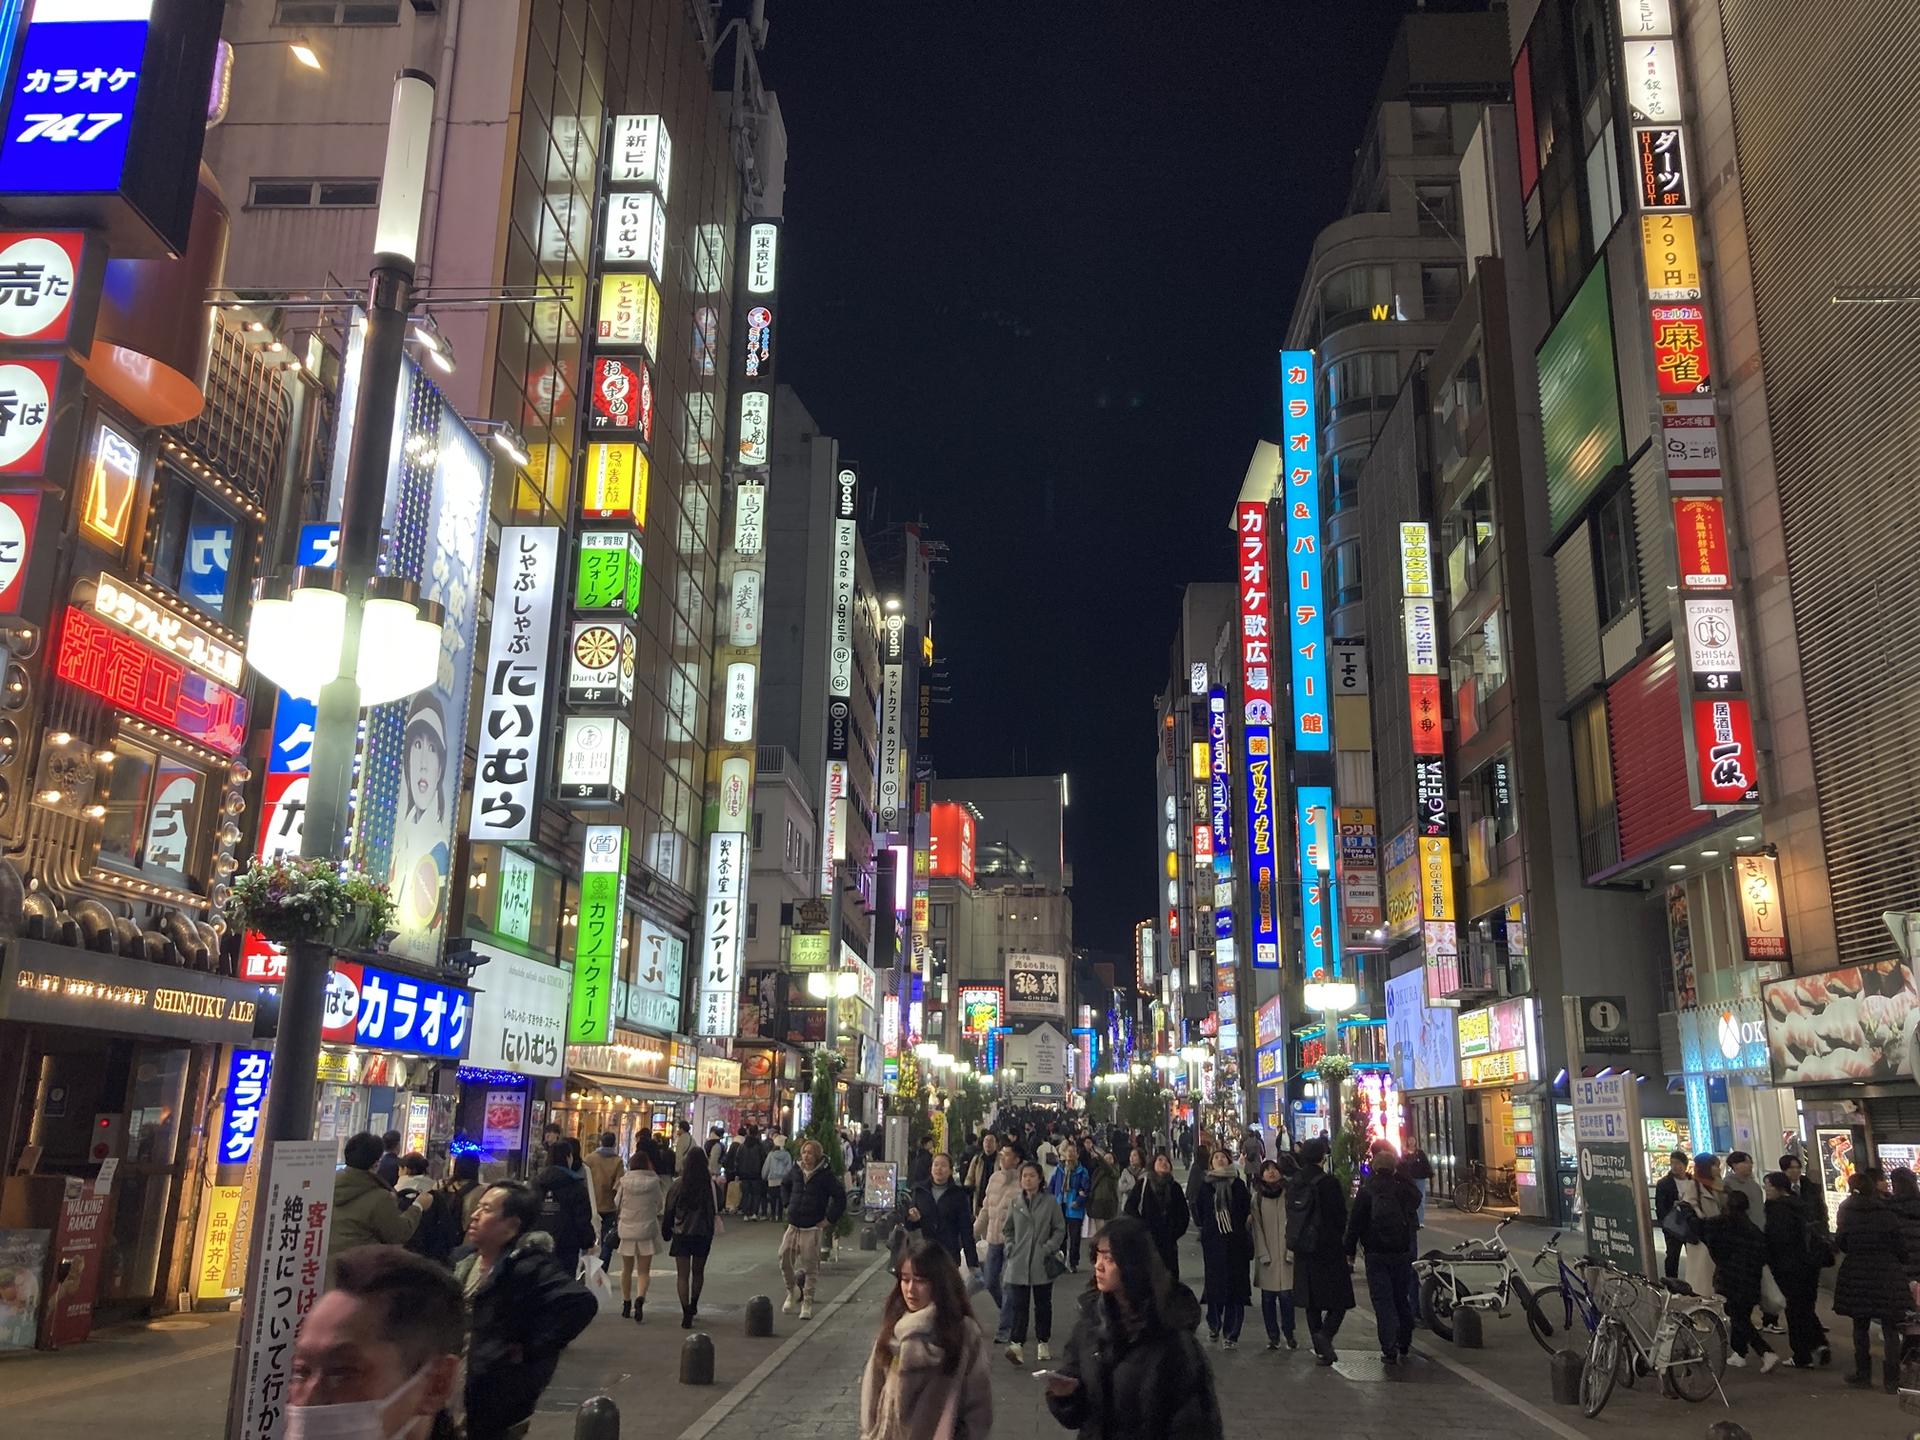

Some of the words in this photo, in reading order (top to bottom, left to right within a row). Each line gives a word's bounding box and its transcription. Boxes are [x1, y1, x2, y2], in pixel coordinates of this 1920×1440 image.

[23, 67, 136, 94] カラオケ
[16, 113, 123, 142] 747
[623, 118, 648, 179] 川新ビル
[1654, 130, 1679, 191] ダーツ
[1641, 132, 1656, 206] HIDEOUT
[1663, 193, 1679, 205] 8F
[617, 196, 640, 259] にいむら
[754, 237, 770, 286] 東京ビル
[1661, 215, 1682, 286] 299円
[1652, 308, 1702, 320] ウェルカム
[1655, 322, 1702, 384] 麻雀
[604, 360, 628, 414] おすすめ
[1696, 383, 1710, 393] 6F
[595, 416, 607, 426] 7F
[838, 469, 856, 515] Booth
[600, 509, 612, 517] 6F
[586, 535, 624, 546] 質・買取
[841, 526, 850, 542] Net
[585, 555, 602, 606] クォーク
[840, 550, 849, 578] Cafe
[507, 534, 537, 654] しゃぶしゃぶ
[1243, 509, 1269, 690] カラオケ歌広場
[836, 594, 849, 642] Capsule
[887, 615, 902, 657] Booth
[1695, 650, 1735, 659] SHISHA
[572, 673, 596, 683] Darts
[597, 672, 618, 684] UP
[584, 689, 600, 699] 4F
[888, 670, 897, 722] ネットカフェ
[1707, 675, 1728, 688] 3F
[830, 701, 847, 751] Booth
[1715, 703, 1732, 742] 居酒屋
[480, 660, 538, 829] にいむら
[885, 739, 896, 775] カプセル
[1712, 744, 1744, 786] 一休
[578, 785, 593, 796] 3F
[1251, 761, 1269, 854] マツモトキヨシ
[1419, 787, 1427, 804] PUB
[1426, 761, 1445, 824] AGEHA
[1342, 824, 1374, 835] つり具
[1427, 825, 1440, 834] 2F
[718, 839, 732, 893] 喫茶室
[914, 899, 927, 921] 麻雀
[1352, 914, 1374, 923] 729
[708, 899, 733, 983] ルノアール
[1750, 938, 1782, 948] 24時間
[1750, 947, 1784, 957] 年中無休
[247, 955, 287, 977] 直売
[153, 988, 226, 1019] SHINJUKU
[228, 1000, 255, 1022] ALE
[357, 976, 468, 1051] カラオケ
[501, 1028, 558, 1067] にいむら
[226, 1053, 266, 1158] カラオケ
[66, 1200, 104, 1216] WALKING
[67, 1215, 99, 1231] RAMEN
[205, 1211, 229, 1282] 品种齐全
